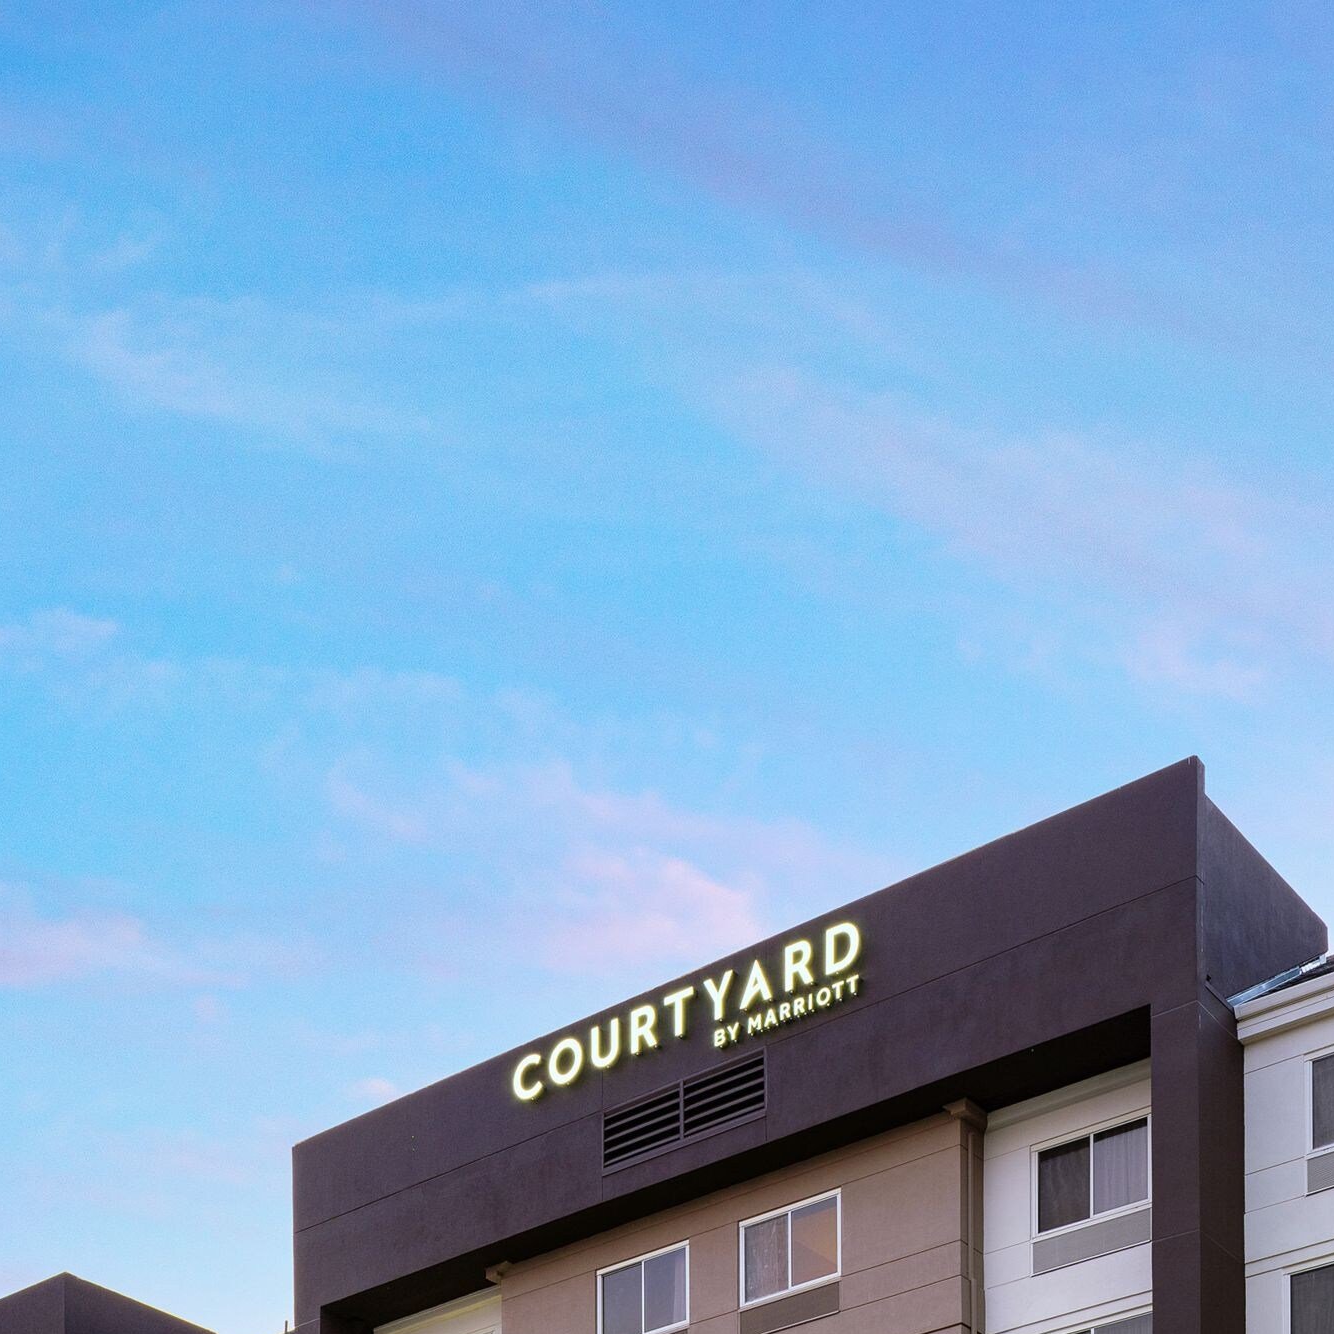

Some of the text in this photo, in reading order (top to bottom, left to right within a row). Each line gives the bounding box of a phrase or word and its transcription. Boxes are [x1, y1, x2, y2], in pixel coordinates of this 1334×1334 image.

[513, 921, 861, 1101] COURTYARD
[713, 974, 860, 1048] BY MARRIOTT
